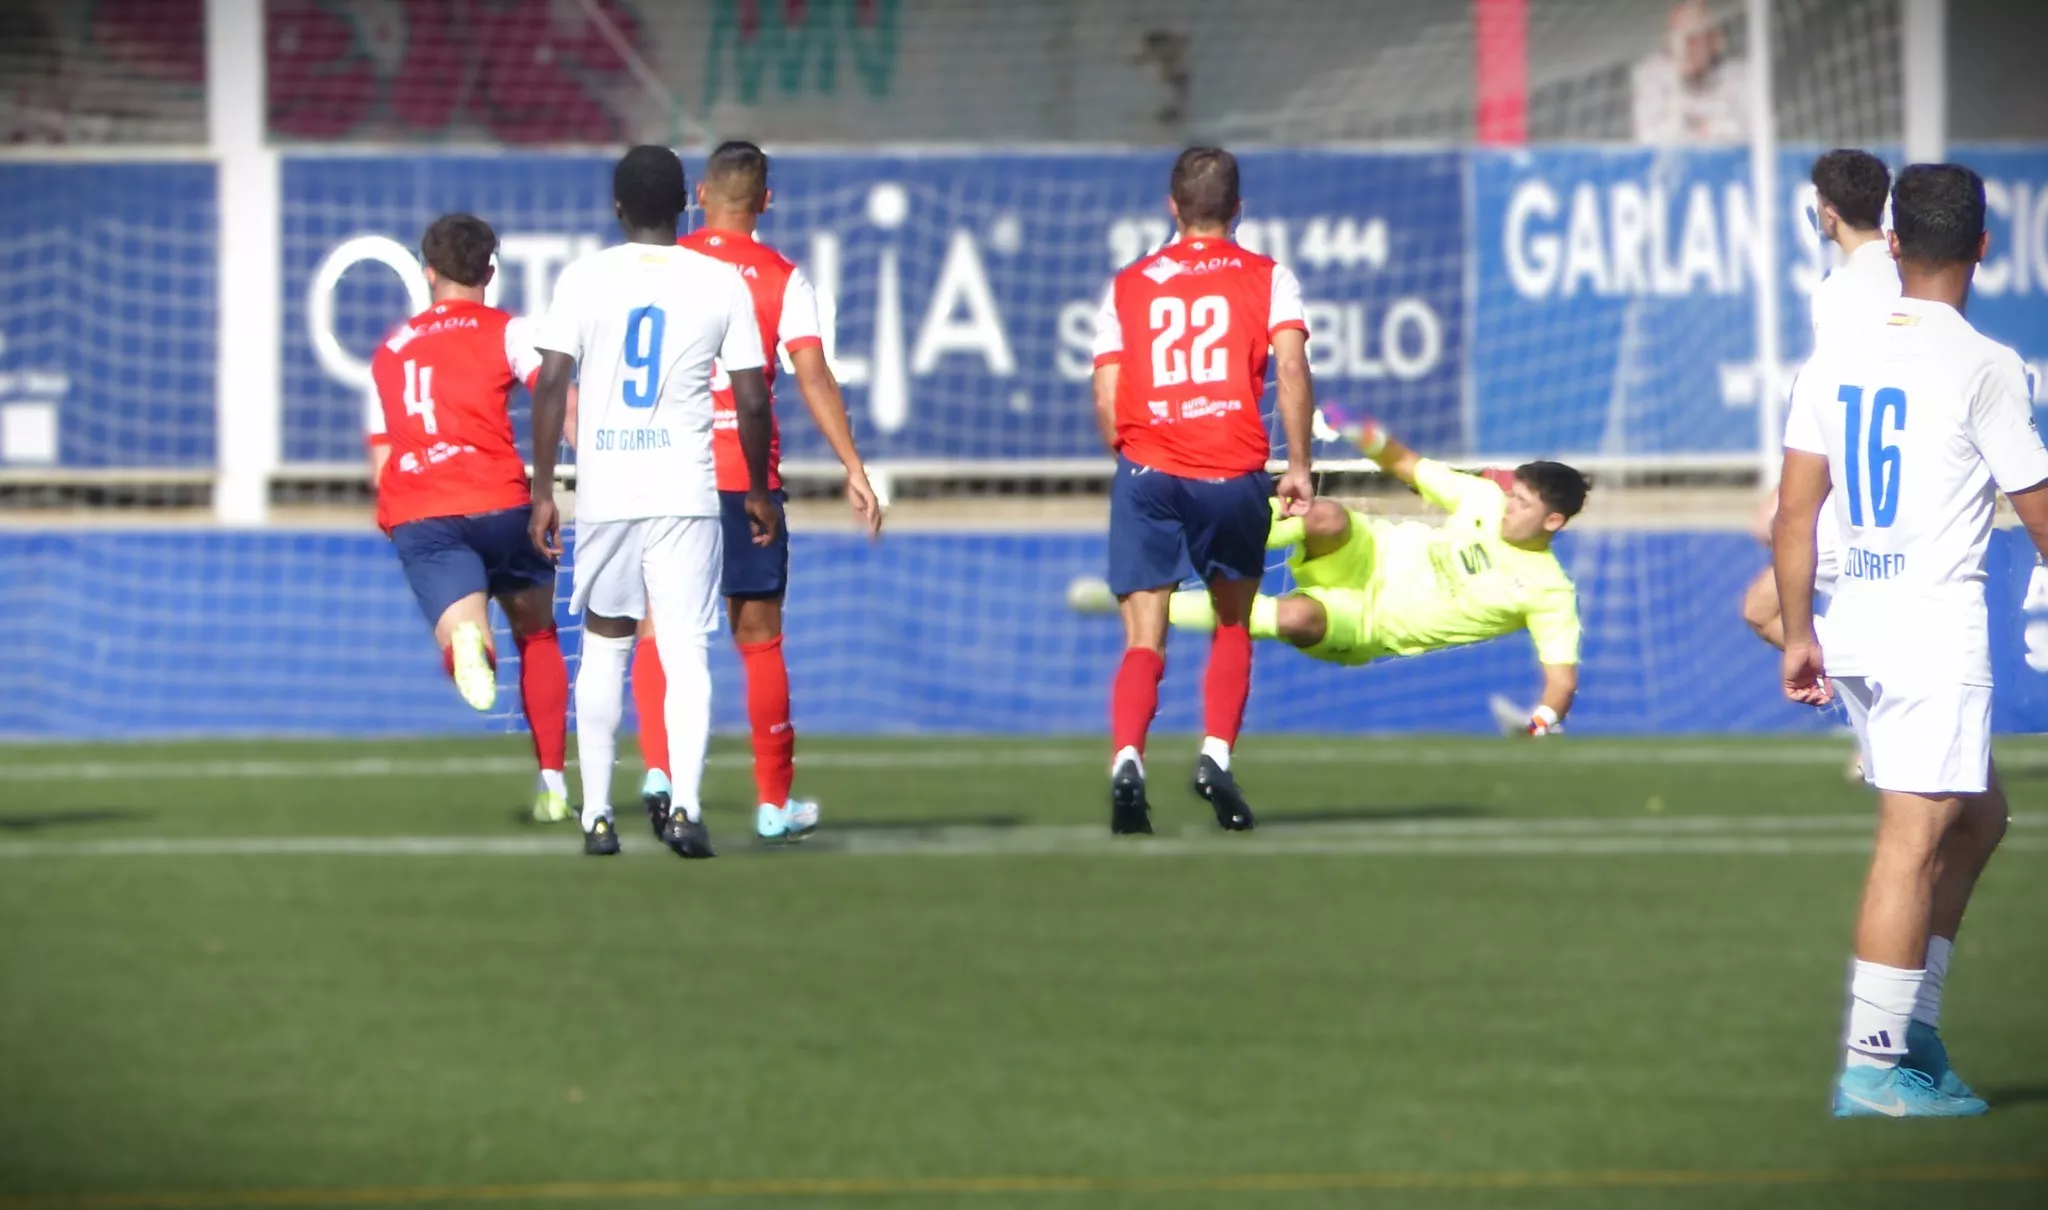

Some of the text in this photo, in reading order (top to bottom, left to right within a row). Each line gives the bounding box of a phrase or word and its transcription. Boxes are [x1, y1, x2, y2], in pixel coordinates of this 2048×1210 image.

[622, 304, 666, 408] 9
[1150, 295, 1230, 388] 22
[403, 359, 438, 435] 4
[1837, 384, 1907, 528] 16
